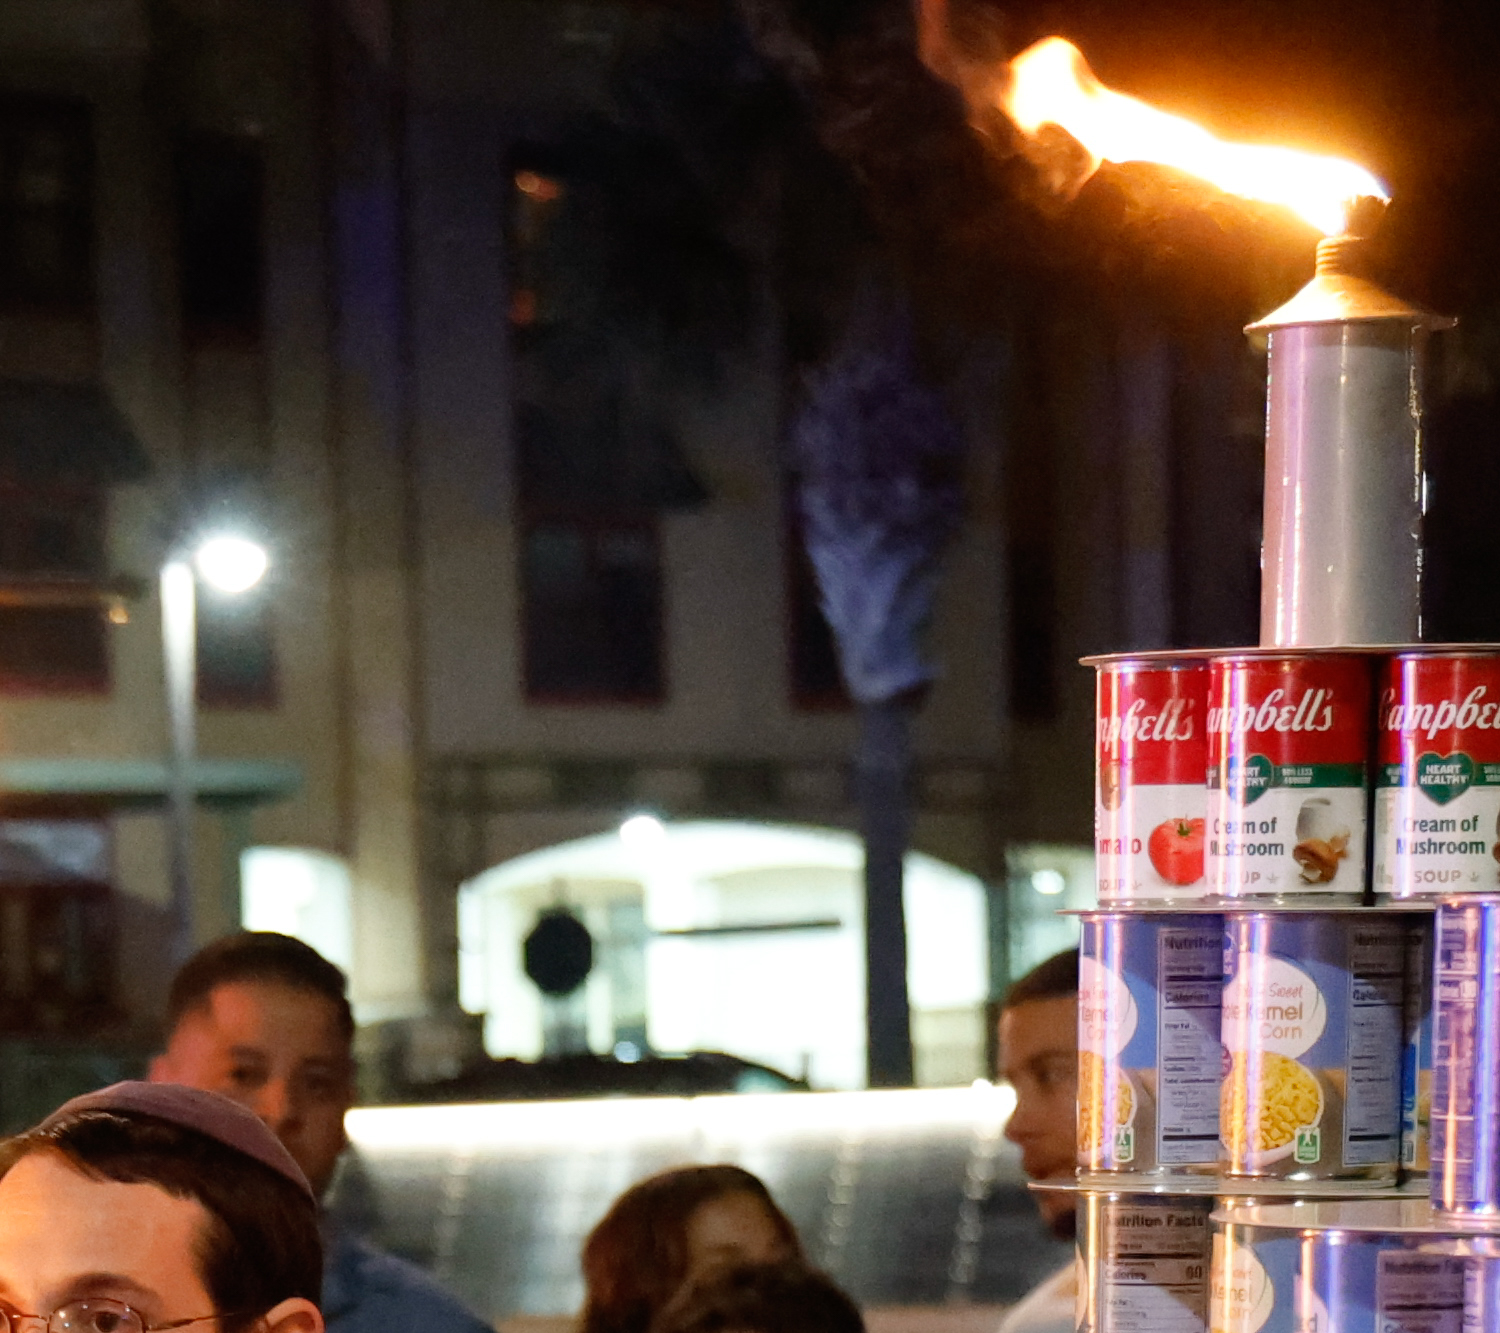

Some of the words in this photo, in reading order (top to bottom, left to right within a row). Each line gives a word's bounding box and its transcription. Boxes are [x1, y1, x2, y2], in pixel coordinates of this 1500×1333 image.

[1206, 688, 1334, 741] ampbell's
[1426, 765, 1461, 774] HEART
[1420, 775, 1468, 785] HEALTHY
[1213, 819, 1256, 834] Cem
[1260, 817, 1277, 834] of
[1403, 817, 1456, 833] Cream
[1461, 814, 1479, 832] of
[1395, 838, 1486, 855] Mushroom
[1221, 871, 1261, 884] SUP
[1414, 871, 1461, 883] SOUP
[1246, 1002, 1303, 1020] Krnel
[1261, 1023, 1302, 1040] Corn
[1112, 1215, 1163, 1227] trition
